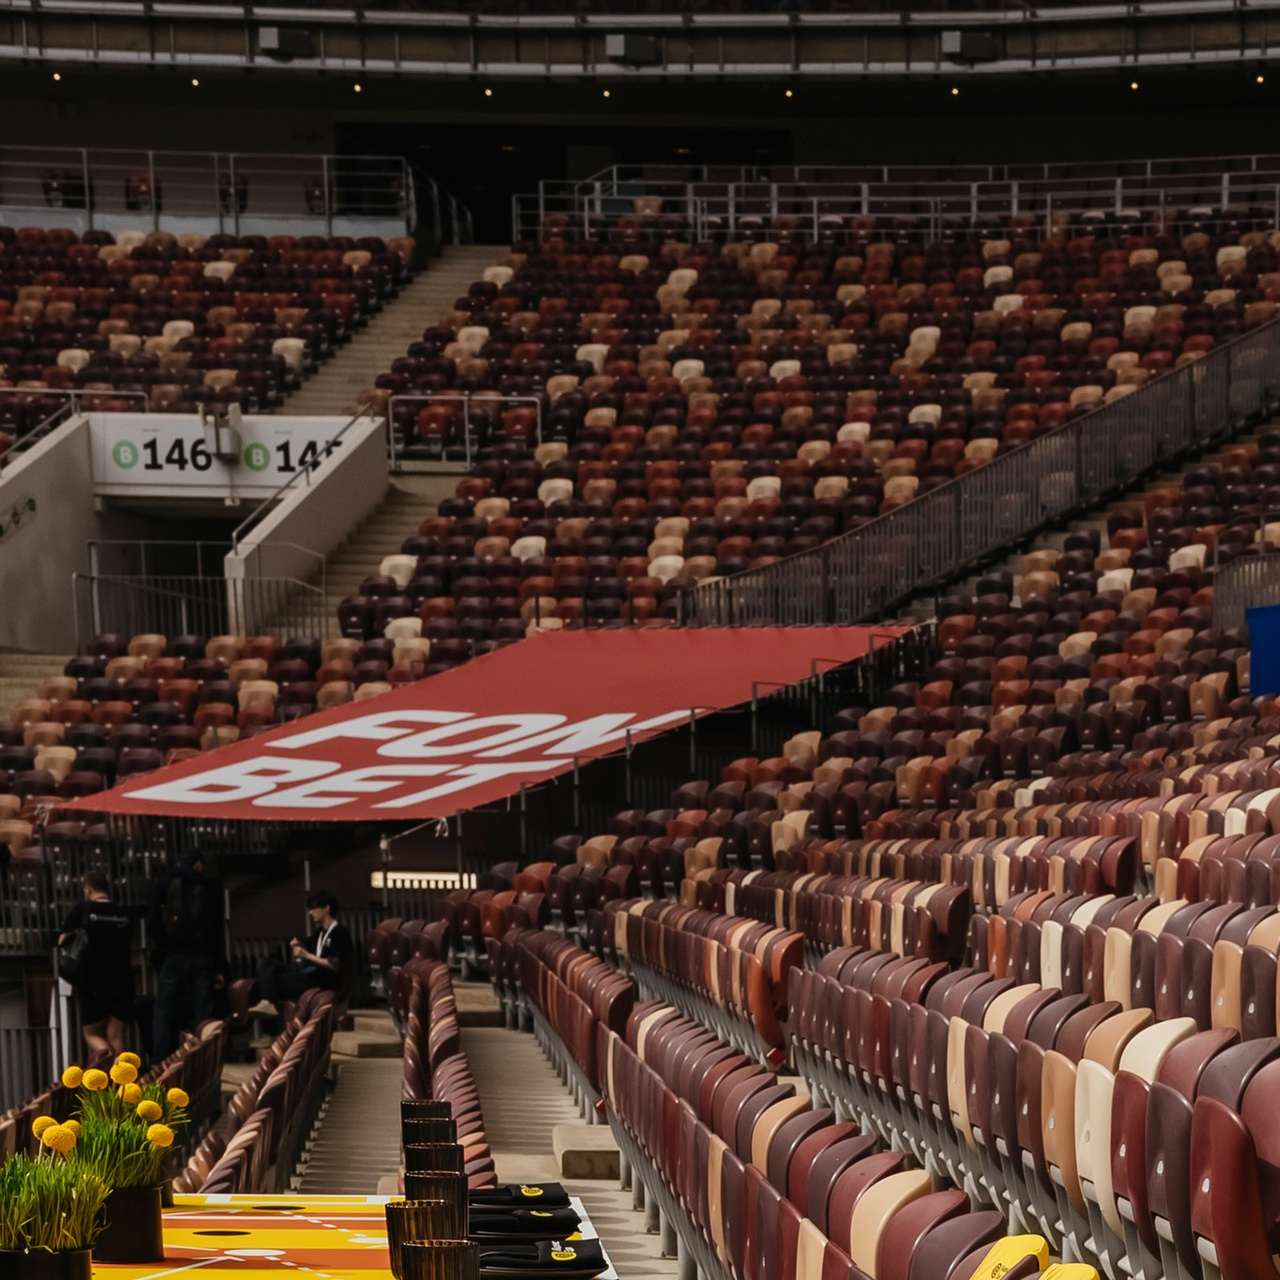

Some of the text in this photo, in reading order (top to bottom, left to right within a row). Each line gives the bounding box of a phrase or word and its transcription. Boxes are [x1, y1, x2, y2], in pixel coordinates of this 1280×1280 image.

[143, 437, 213, 471] 146
[264, 708, 706, 758] FON
[121, 755, 575, 809] BET
